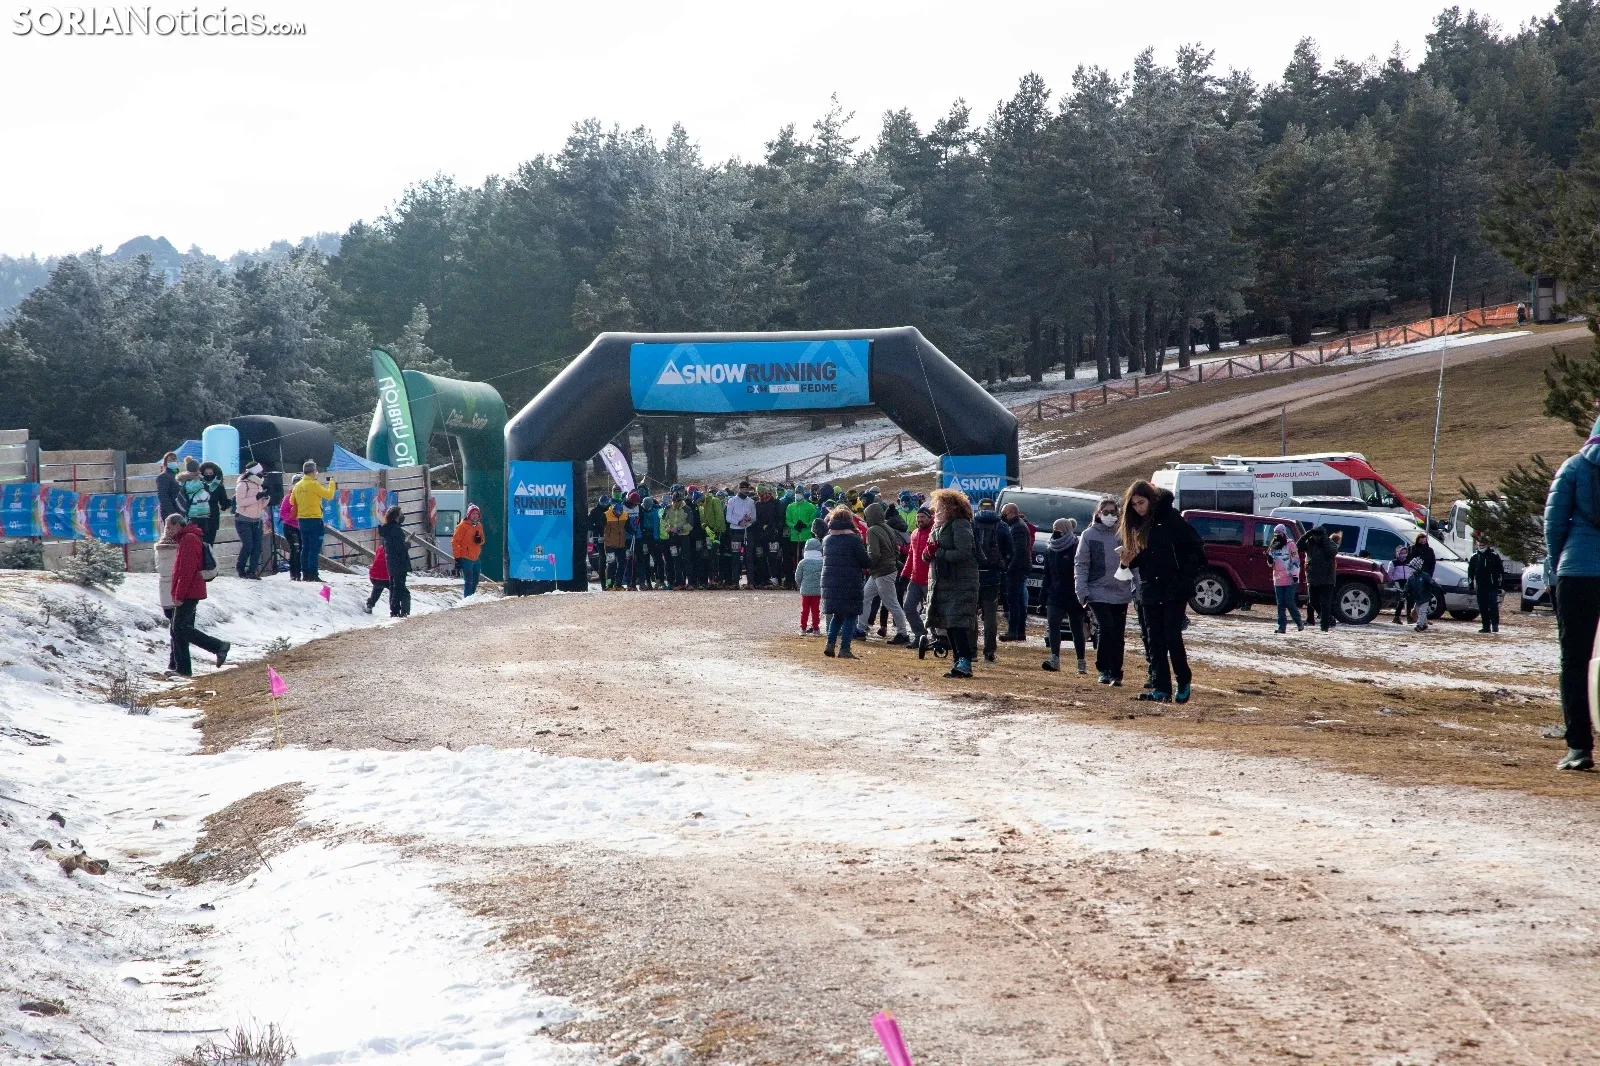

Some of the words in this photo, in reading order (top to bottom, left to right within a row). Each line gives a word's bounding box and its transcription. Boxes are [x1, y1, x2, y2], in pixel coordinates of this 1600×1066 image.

[801, 383, 838, 393] FEDME
[1273, 471, 1320, 479] AMBULANCIA
[960, 477, 1001, 491] SNOW
[527, 483, 567, 497] SNOW
[1270, 490, 1288, 499] Roja
[513, 496, 567, 509] RUNNING
